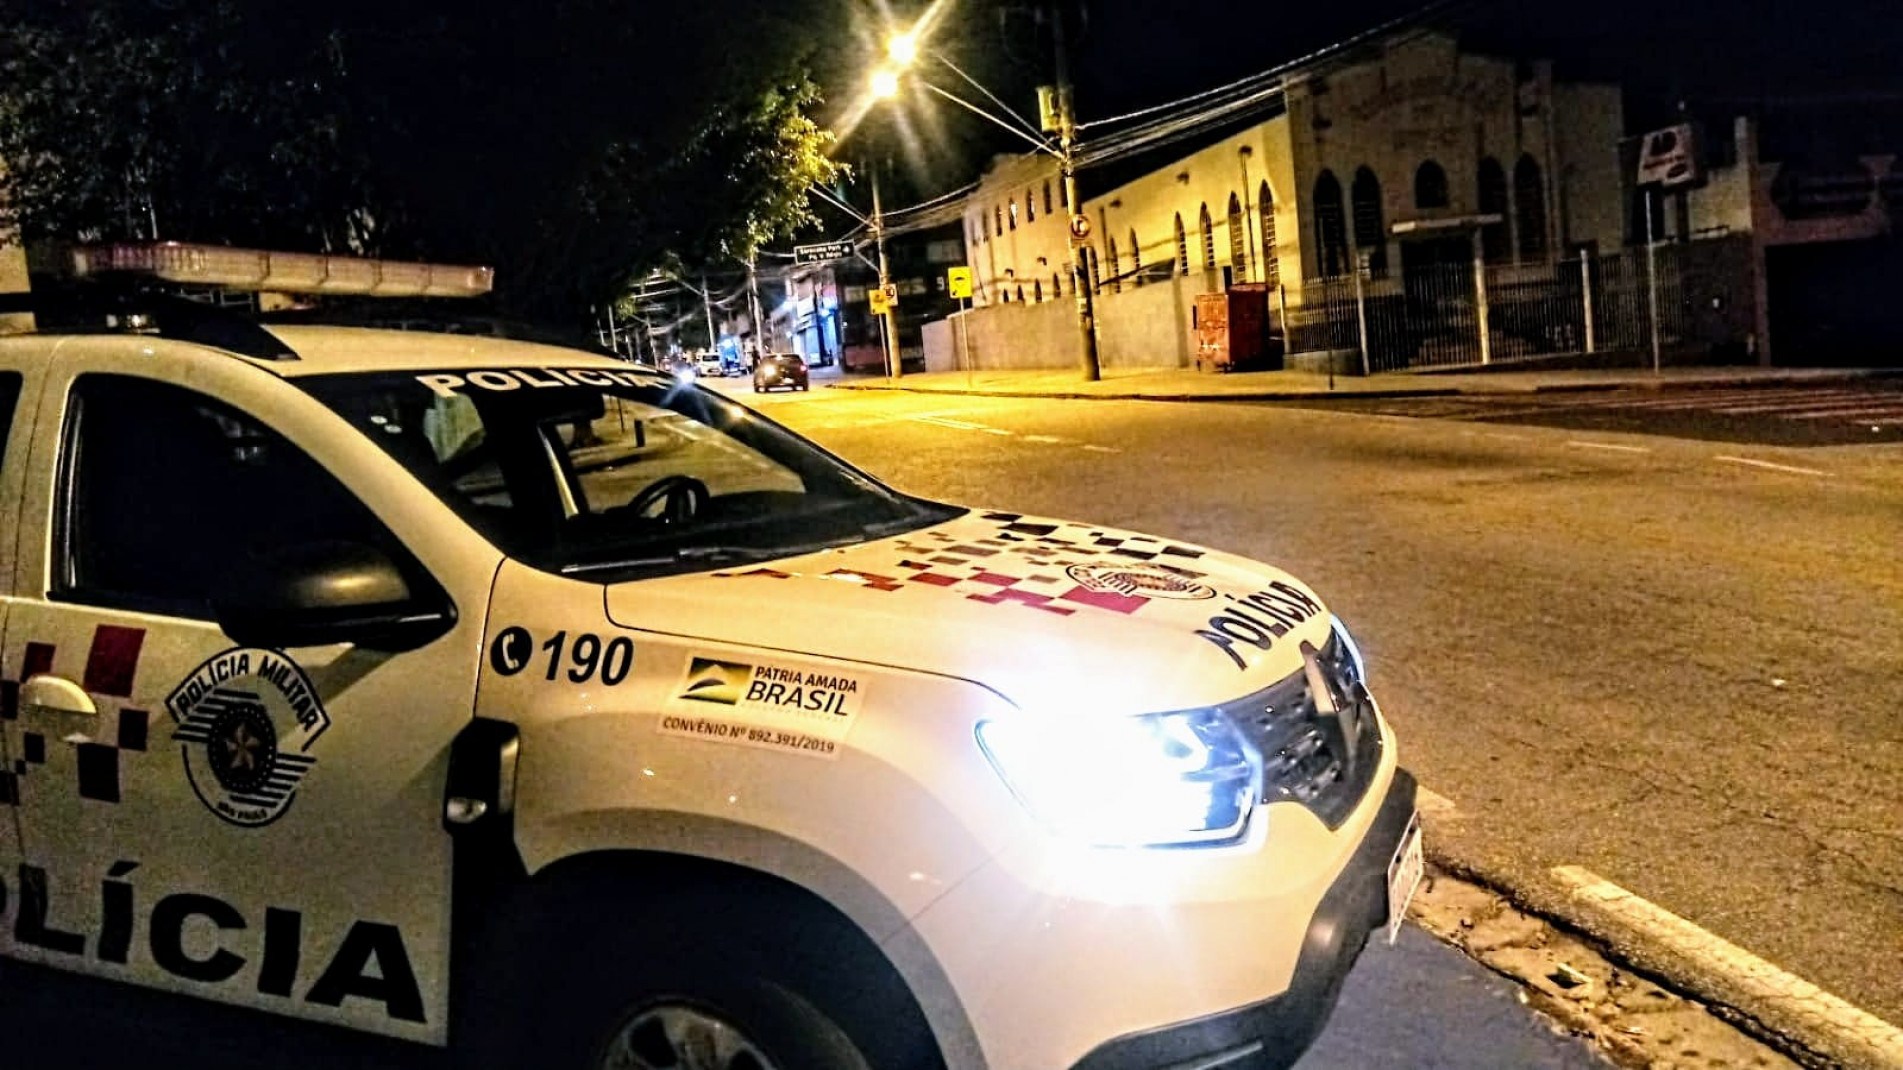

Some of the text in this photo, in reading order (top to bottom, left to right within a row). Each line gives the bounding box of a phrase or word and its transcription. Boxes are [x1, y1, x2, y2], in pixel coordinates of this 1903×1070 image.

[1194, 581, 1321, 671] POLÍCIA
[541, 630, 634, 686] 190
[755, 664, 858, 693] PÁTRIA AMADA
[257, 656, 319, 732] MILITAR
[745, 680, 849, 717] BRASIL
[663, 715, 728, 737] CONVÊNIO
[748, 730, 835, 753] 892.391/2019
[0, 861, 427, 1024] LÍCIA
